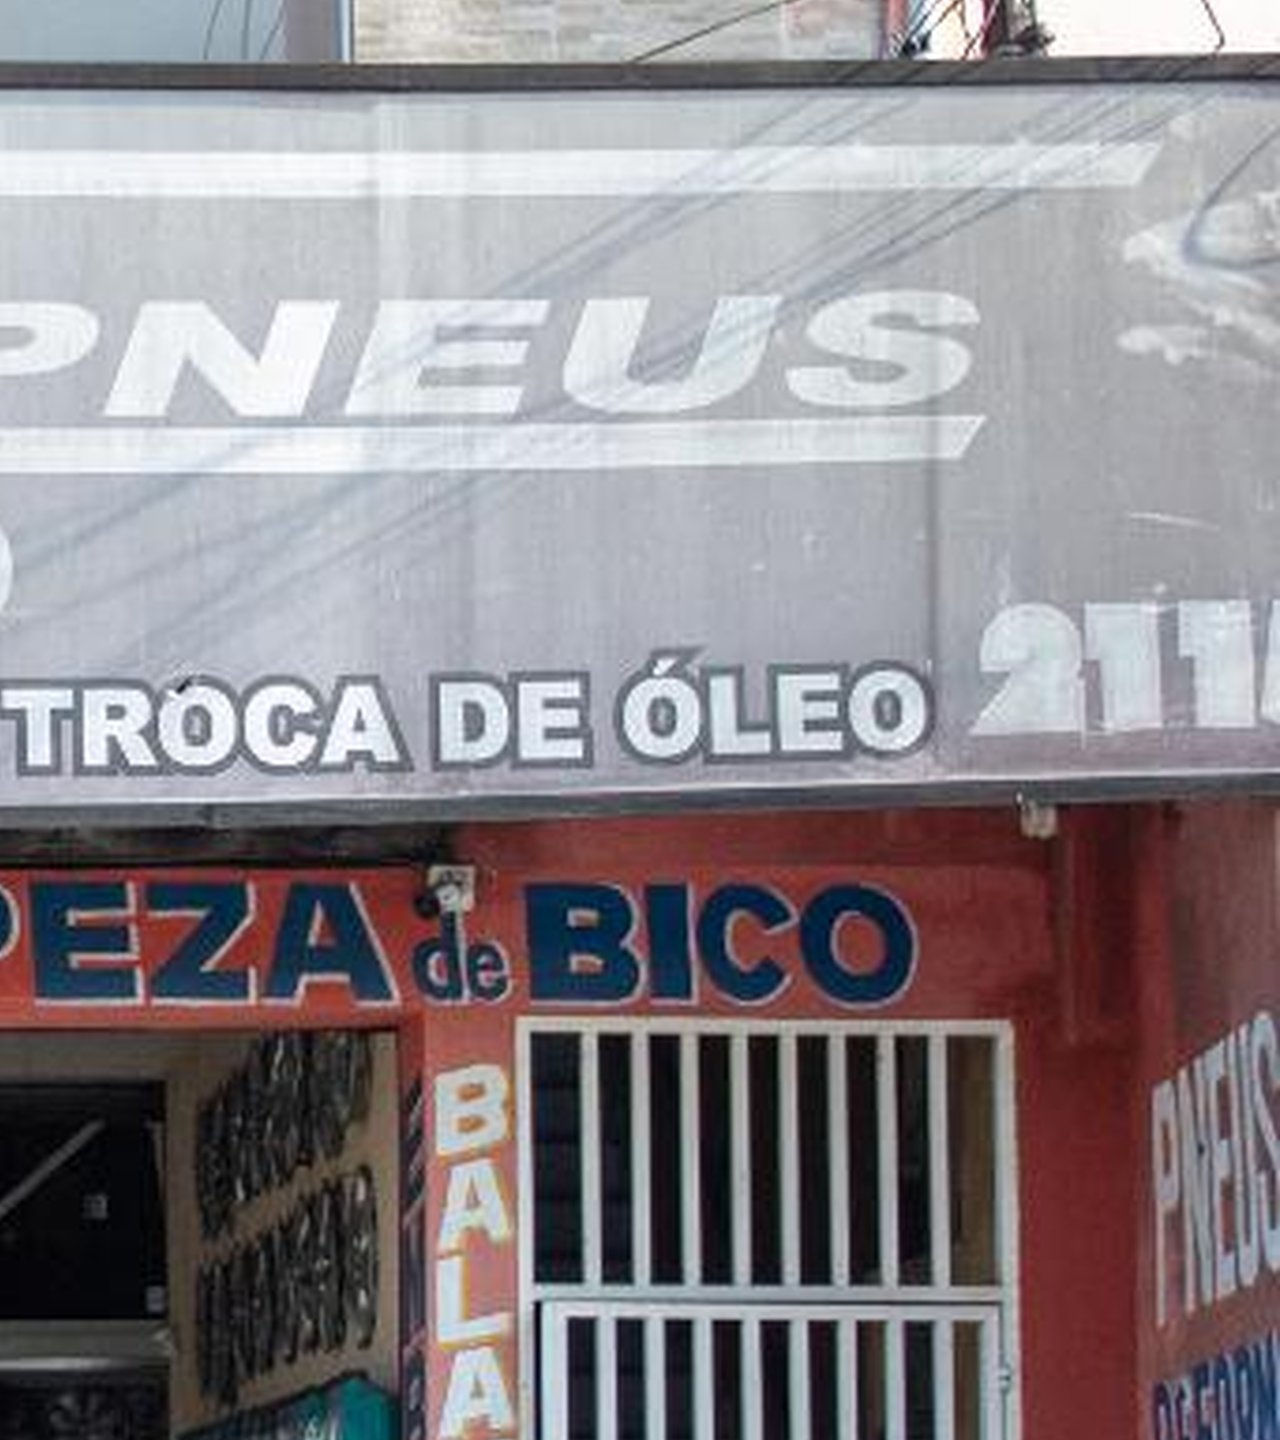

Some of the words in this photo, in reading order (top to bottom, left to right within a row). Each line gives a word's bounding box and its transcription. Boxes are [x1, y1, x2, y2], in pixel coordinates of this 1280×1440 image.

[438, 680, 587, 763] DE
[621, 653, 929, 763] ÓLEO
[967, 599, 1280, 735] 211
[412, 905, 513, 1007] de
[523, 879, 919, 1010] BICO
[1150, 1010, 1280, 1328] PNEUS
